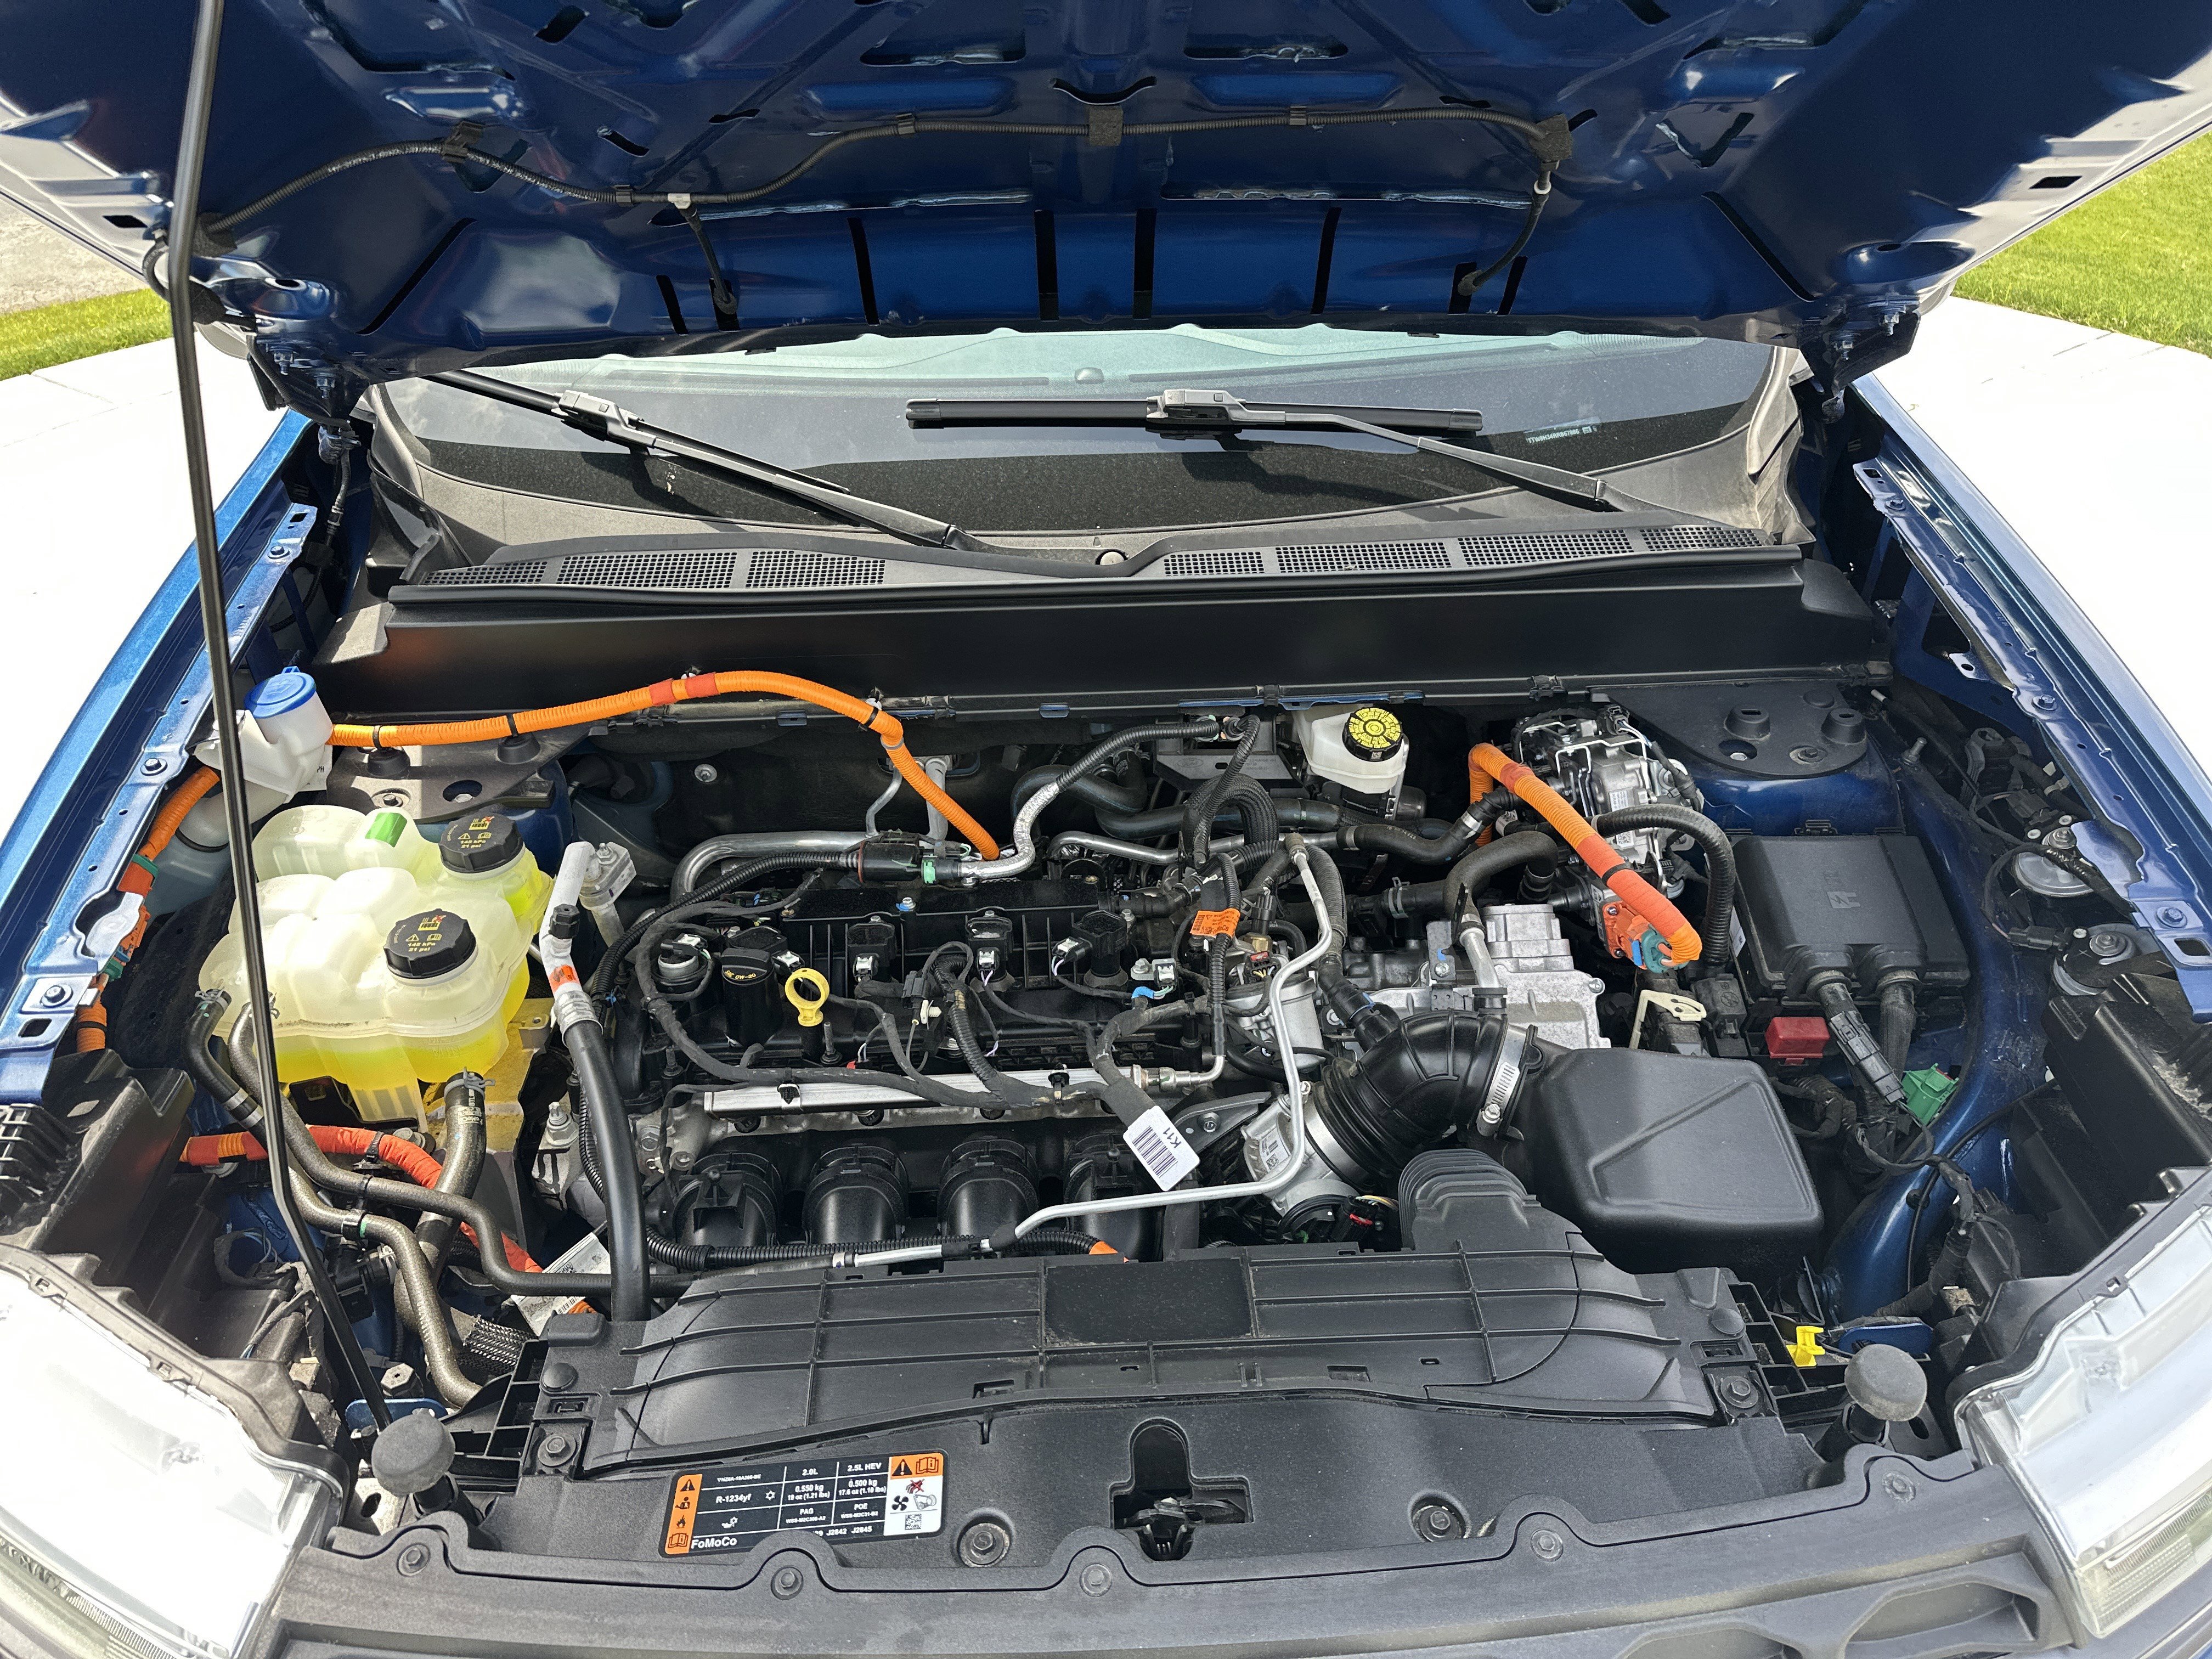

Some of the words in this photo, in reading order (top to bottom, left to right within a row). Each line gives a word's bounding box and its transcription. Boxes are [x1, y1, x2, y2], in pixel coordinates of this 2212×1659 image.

[1163, 1127, 1182, 1149] K11
[865, 1462, 882, 1470] HEV
[848, 1479, 867, 1488] 0.500
[868, 1479, 878, 1487] kg
[795, 1484, 814, 1493] 0.550
[815, 1484, 824, 1492] kg
[715, 1493, 752, 1504] R-1234yf
[803, 1492, 818, 1500] (1.21
[826, 1528, 848, 1536] J2842
[851, 1526, 872, 1534] J2845
[691, 1536, 737, 1549] FoMoCo
